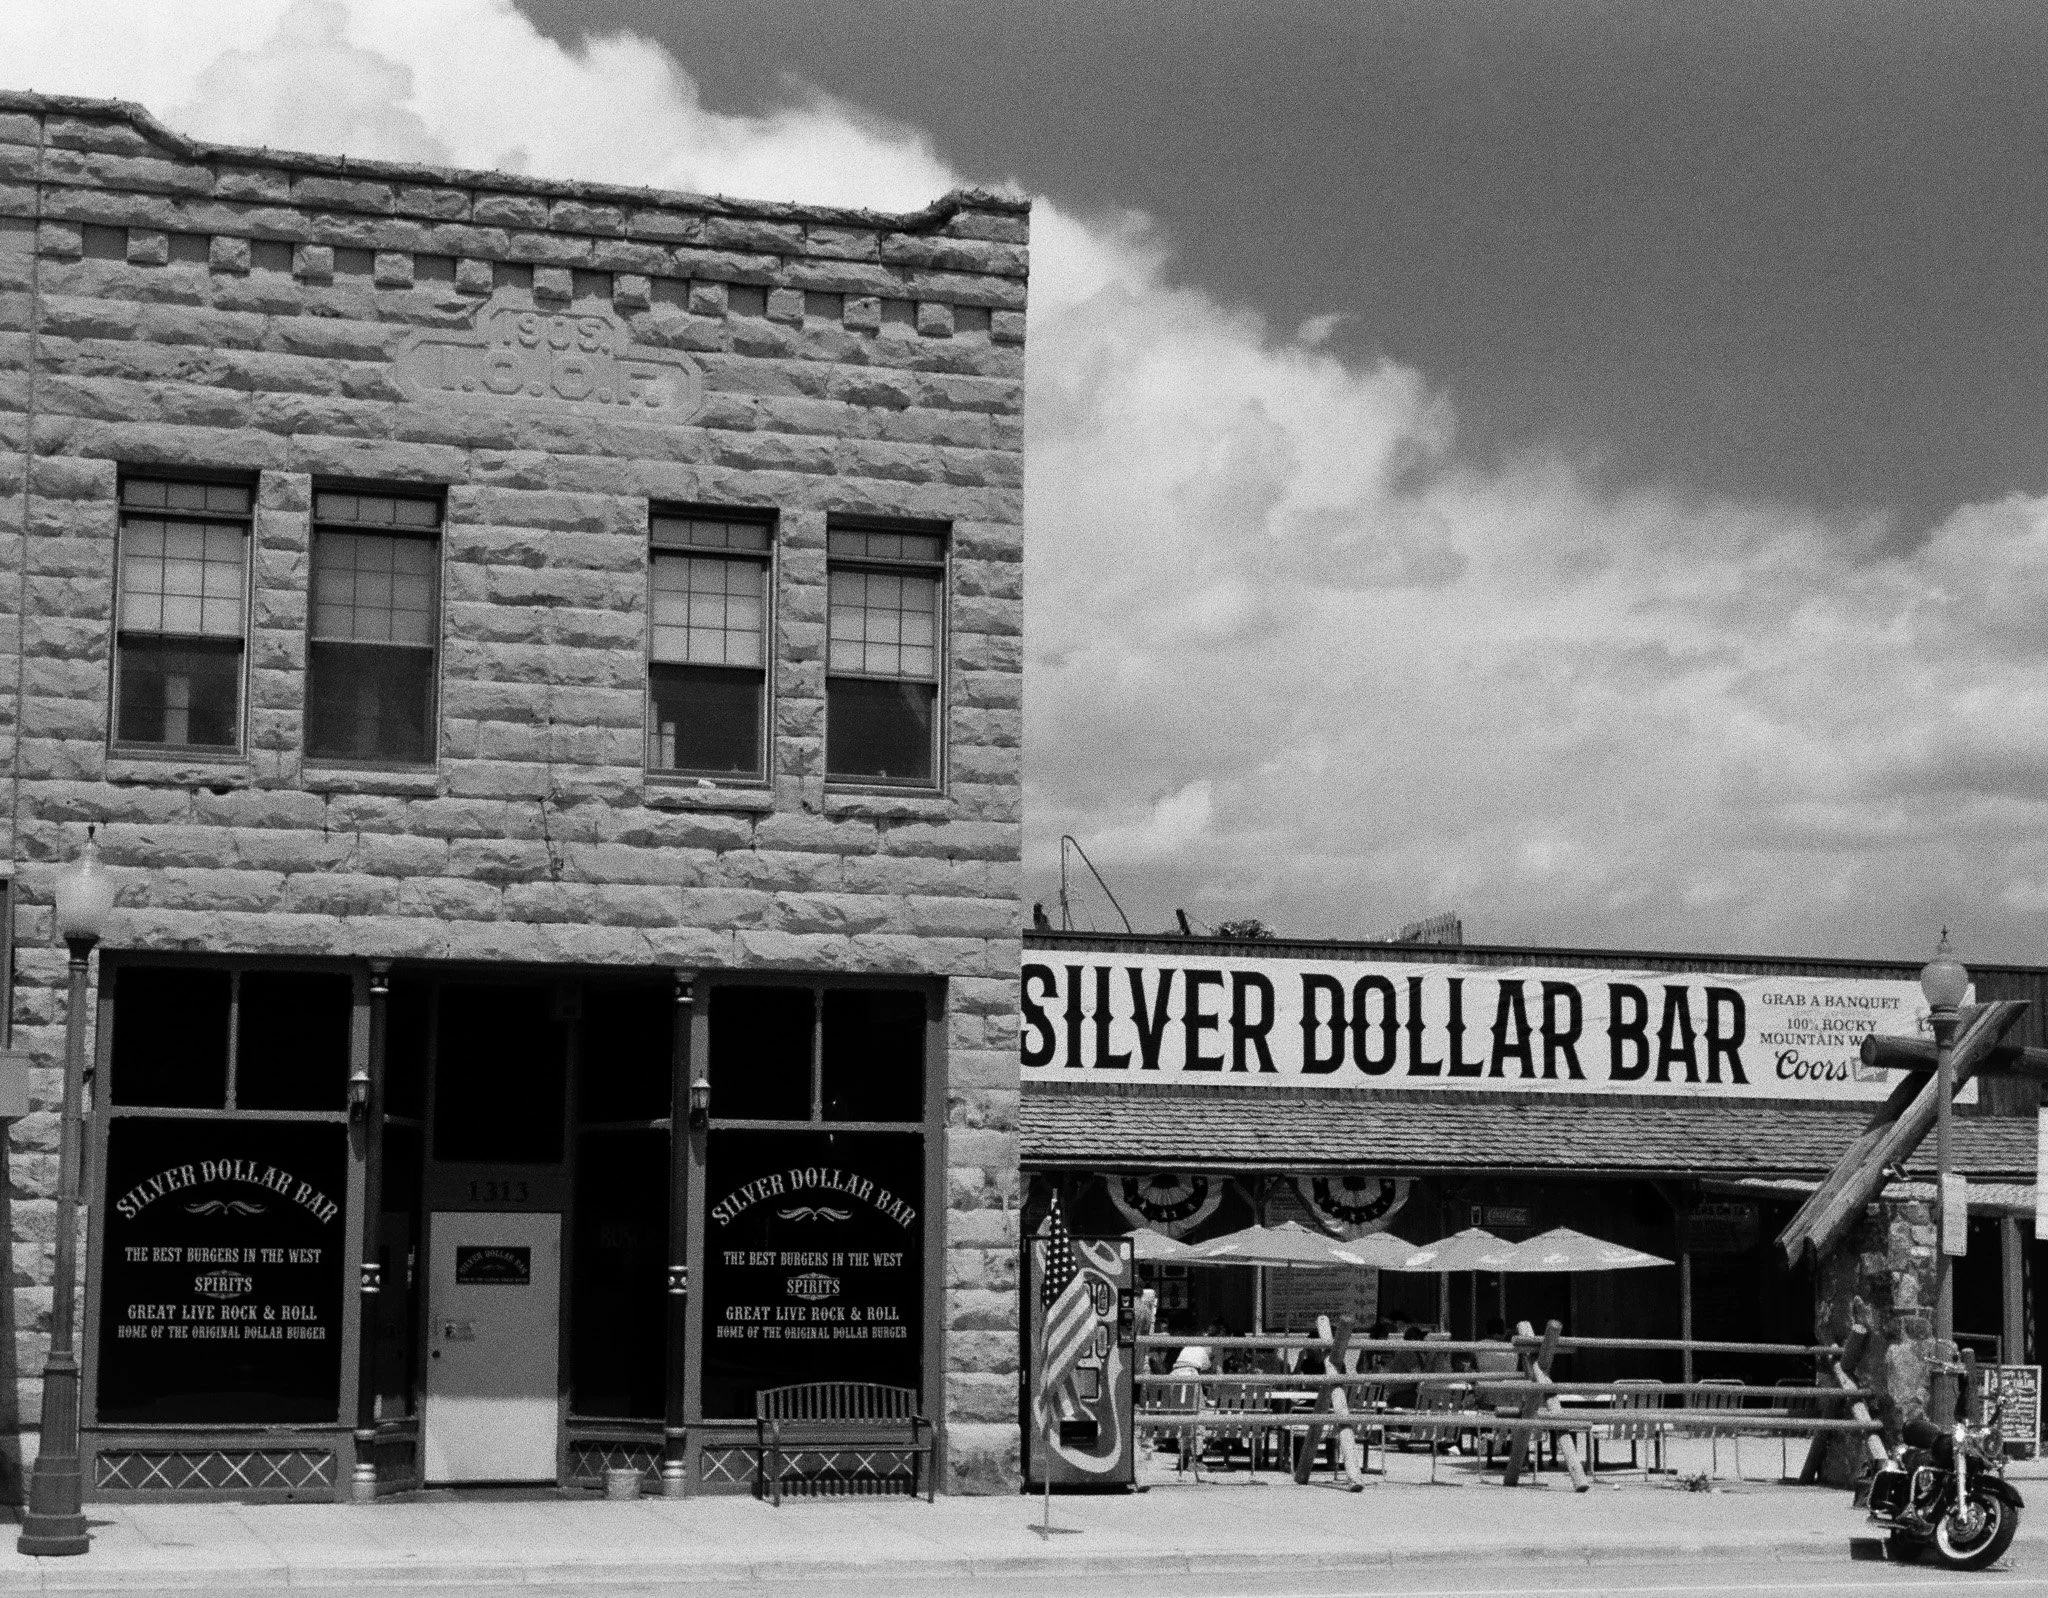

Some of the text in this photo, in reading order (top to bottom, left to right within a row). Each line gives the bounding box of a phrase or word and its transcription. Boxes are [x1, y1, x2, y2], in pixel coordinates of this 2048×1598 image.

[1762, 994, 1900, 1010] GRAB A BANQUET
[1020, 963, 1751, 1085] SILVER DOLLAR BAR
[1822, 1019, 1877, 1032] ROCKY
[1760, 1033, 1845, 1046] MOUNTAIN
[1774, 1049, 1849, 1082] Coors
[115, 1158, 339, 1224] SILVER DOLLAR BAR
[468, 1180, 530, 1203] 1313
[711, 1167, 917, 1229] SILVER DOLLAR BAR
[125, 1247, 321, 1263] THE BEST BURGERS IN THE WEST
[723, 1251, 903, 1266] THE BEST BURGERS IN THE WEST
[195, 1277, 252, 1292] SPIRITS
[787, 1279, 840, 1294] SPIRITS
[128, 1305, 317, 1320] GREAT LIVE ROCK & ROLL
[726, 1306, 899, 1321] GREAT LIVE ROCK & ROLL
[118, 1325, 325, 1340] HOME OF THE ORIGINAL DOLLAR BURGER
[717, 1326, 907, 1339] HOME OF THE ORIGINAL DOLLAR BURGER
